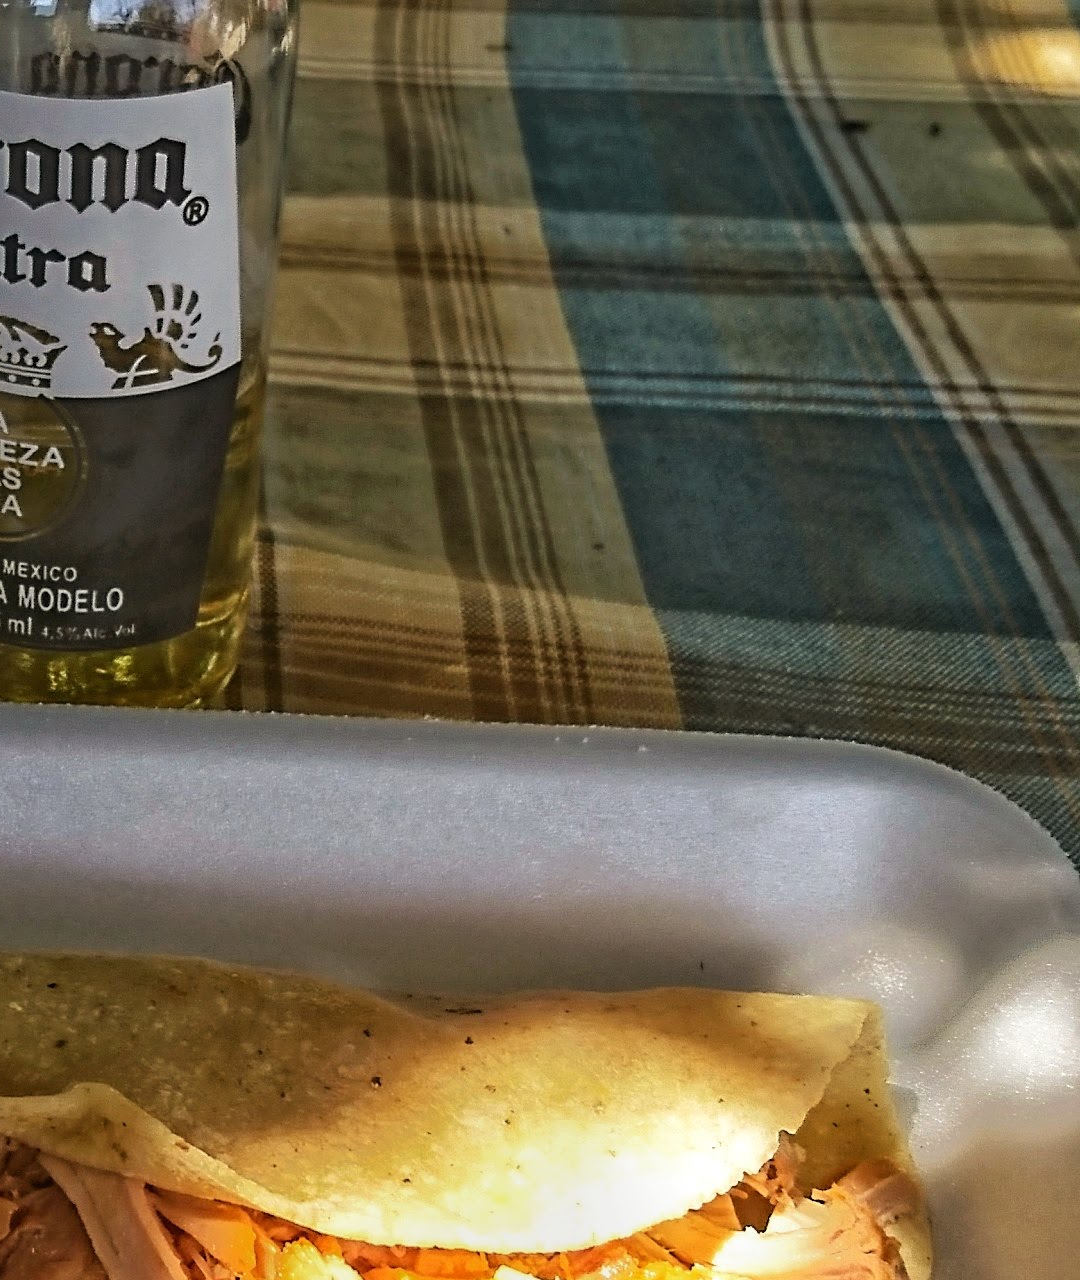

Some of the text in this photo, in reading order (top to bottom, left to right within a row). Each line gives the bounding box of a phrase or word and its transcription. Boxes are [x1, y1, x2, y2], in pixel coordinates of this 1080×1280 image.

[3, 558, 78, 582] MEXICO
[18, 583, 124, 613] MODELO
[8, 616, 33, 636] ml
